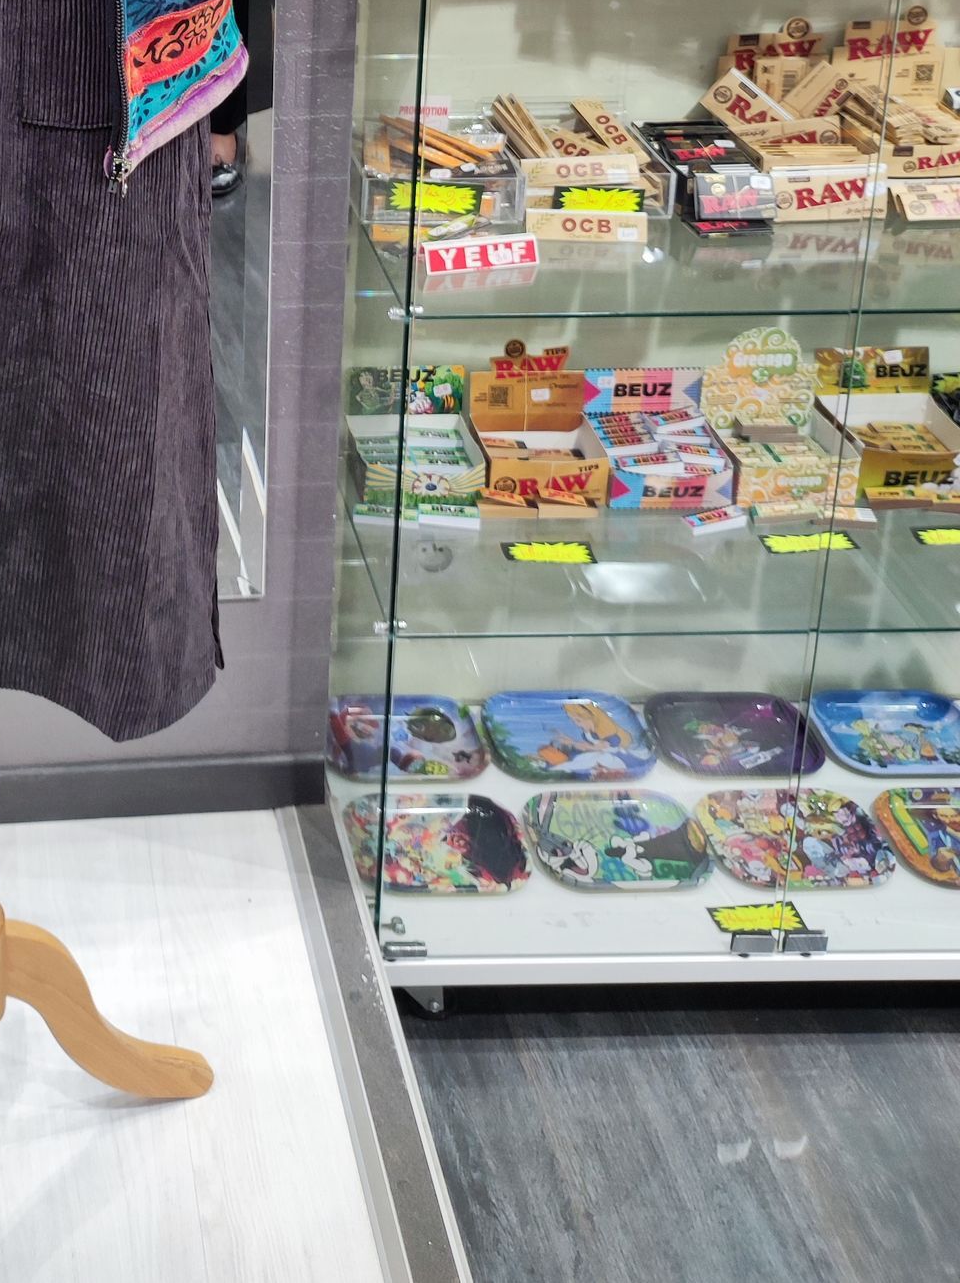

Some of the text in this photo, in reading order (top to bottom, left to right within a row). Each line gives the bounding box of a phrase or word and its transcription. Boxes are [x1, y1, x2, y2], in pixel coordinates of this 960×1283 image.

[846, 28, 934, 62] RAW
[725, 93, 779, 125] RA
[595, 114, 628, 146] OCB
[551, 137, 591, 157] OCB
[556, 161, 606, 179] OCB
[794, 177, 868, 211] RAW
[561, 217, 613, 234] OCB
[494, 355, 565, 380] RAW
[876, 363, 928, 378] BEUZ
[613, 383, 673, 398] BEUZ
[518, 472, 593, 498] RAW
[883, 469, 955, 487] BEUZ
[642, 485, 705, 499] BEUZ
